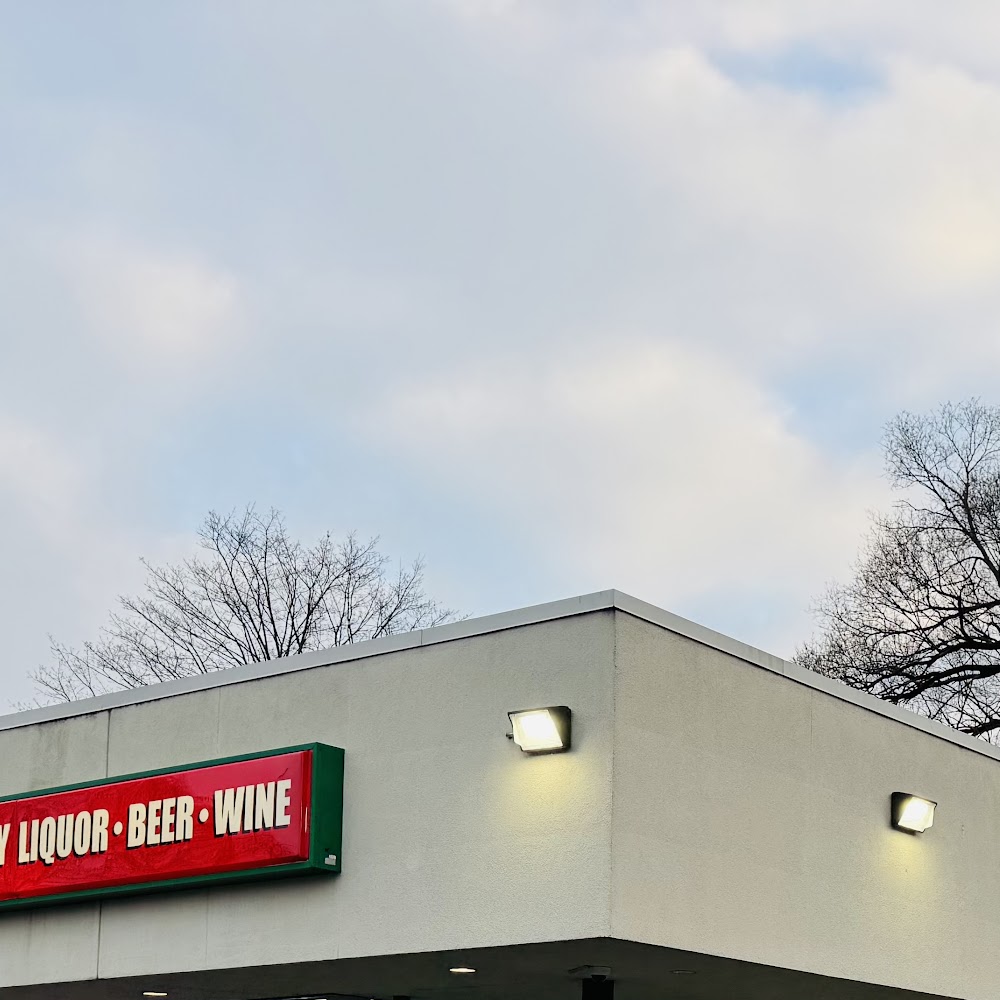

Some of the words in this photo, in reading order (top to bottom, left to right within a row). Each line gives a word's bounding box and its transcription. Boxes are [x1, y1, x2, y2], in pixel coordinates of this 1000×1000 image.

[17, 808, 109, 865] LIQUOR
[126, 795, 195, 849] BEER
[213, 779, 292, 838] WINE
